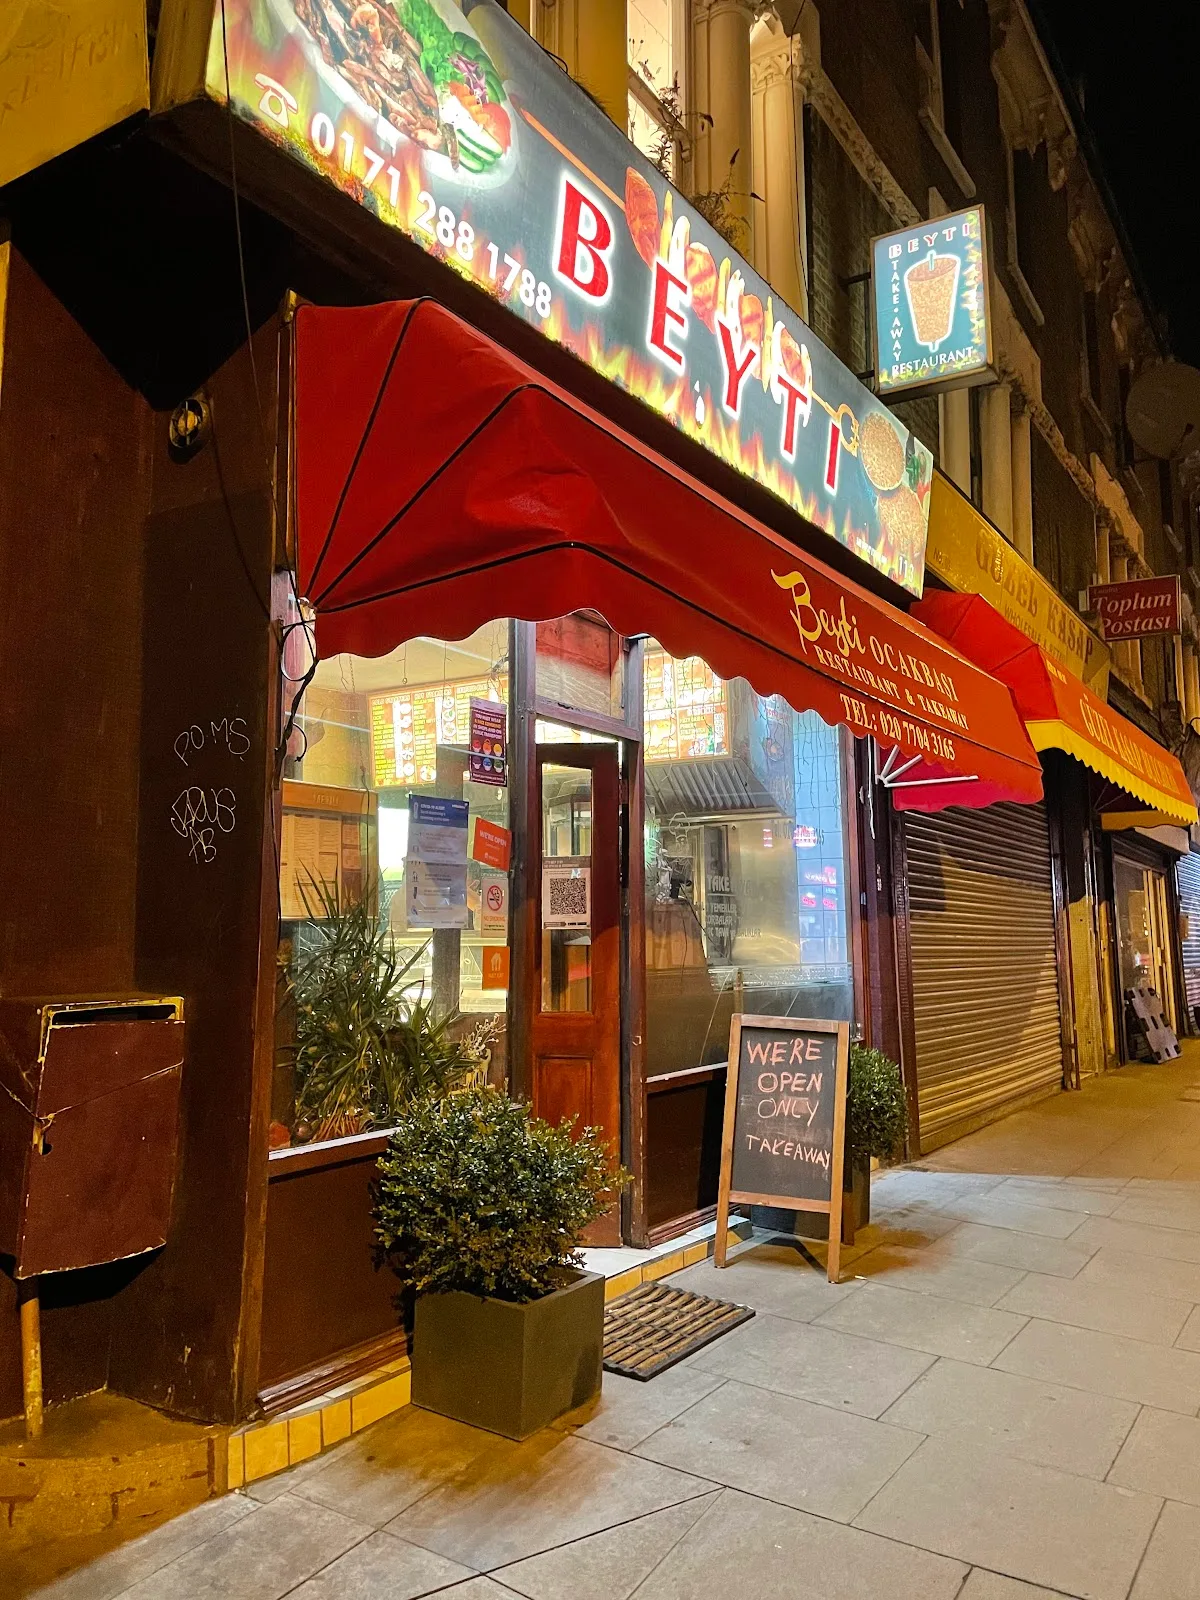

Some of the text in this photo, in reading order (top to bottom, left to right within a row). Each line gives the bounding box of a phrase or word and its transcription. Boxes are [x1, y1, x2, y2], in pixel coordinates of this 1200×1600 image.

[311, 111, 552, 319] 0171 288 1788
[889, 223, 970, 259] BEYTI
[552, 170, 841, 497] BEYTI
[892, 346, 974, 377] RESTAURANT
[770, 569, 866, 658] Beyti
[1093, 592, 1172, 616] Toplum
[814, 644, 970, 731] RESTAURANT & TAKEAWAY
[839, 693, 956, 760] TEL: 020 7704 3165
[747, 1038, 825, 1066] WE'RE
[758, 1072, 823, 1093] OPEN
[757, 1098, 819, 1127] ONLY
[746, 1134, 831, 1170] TAKEAWAY
